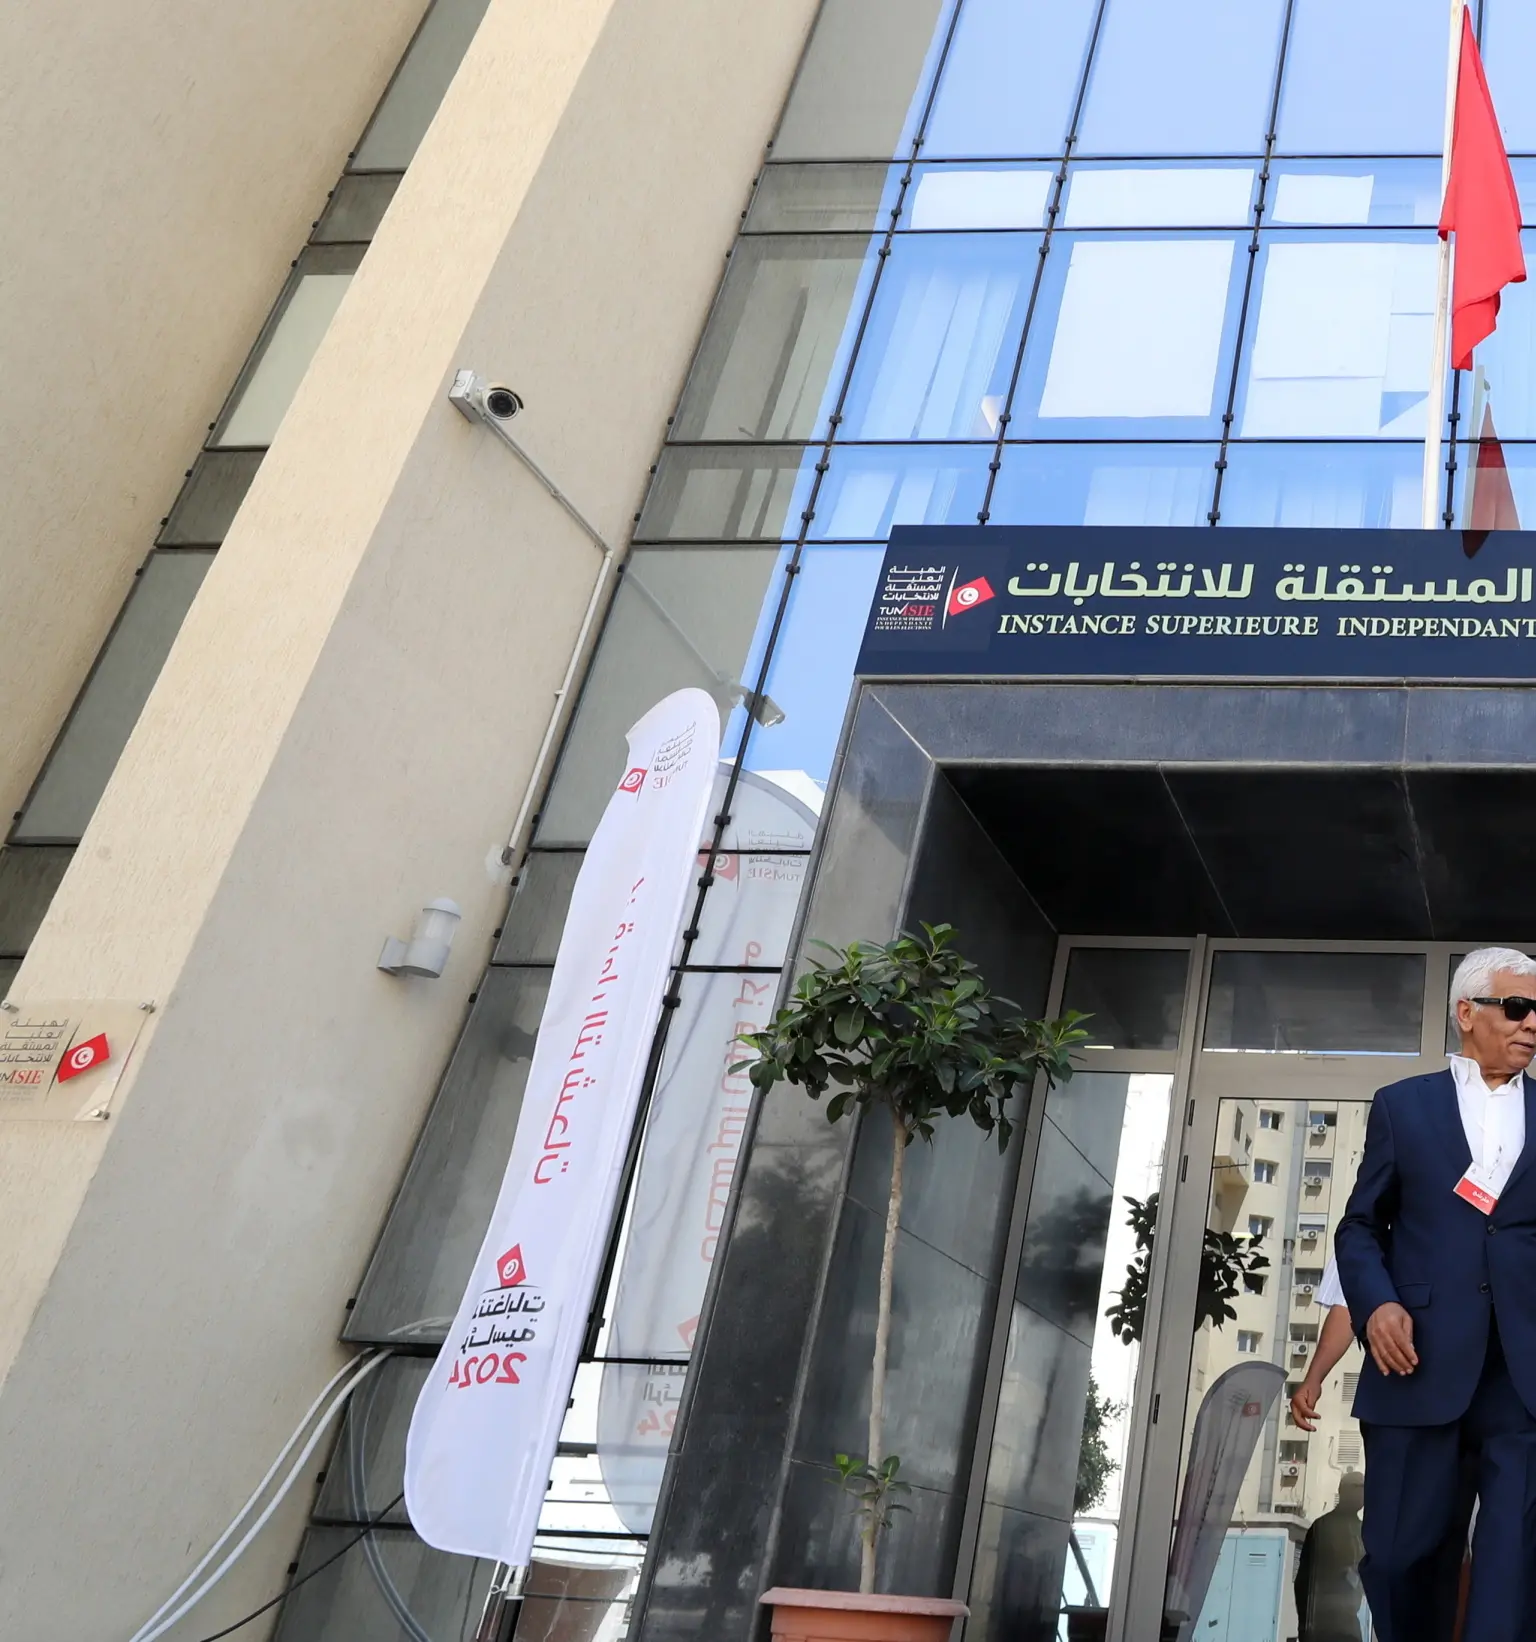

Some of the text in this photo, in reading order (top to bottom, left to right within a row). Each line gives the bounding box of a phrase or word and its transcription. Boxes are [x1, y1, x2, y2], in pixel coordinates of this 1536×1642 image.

[884, 583, 942, 591] المستقلة
[887, 574, 944, 584] العليا
[1006, 561, 1255, 606] للانتخابات
[1274, 562, 1533, 604] المستقلة
[882, 592, 940, 602] للانتخابات
[998, 613, 1135, 635] INSTANCE
[1146, 613, 1319, 636] SUPERIEURE
